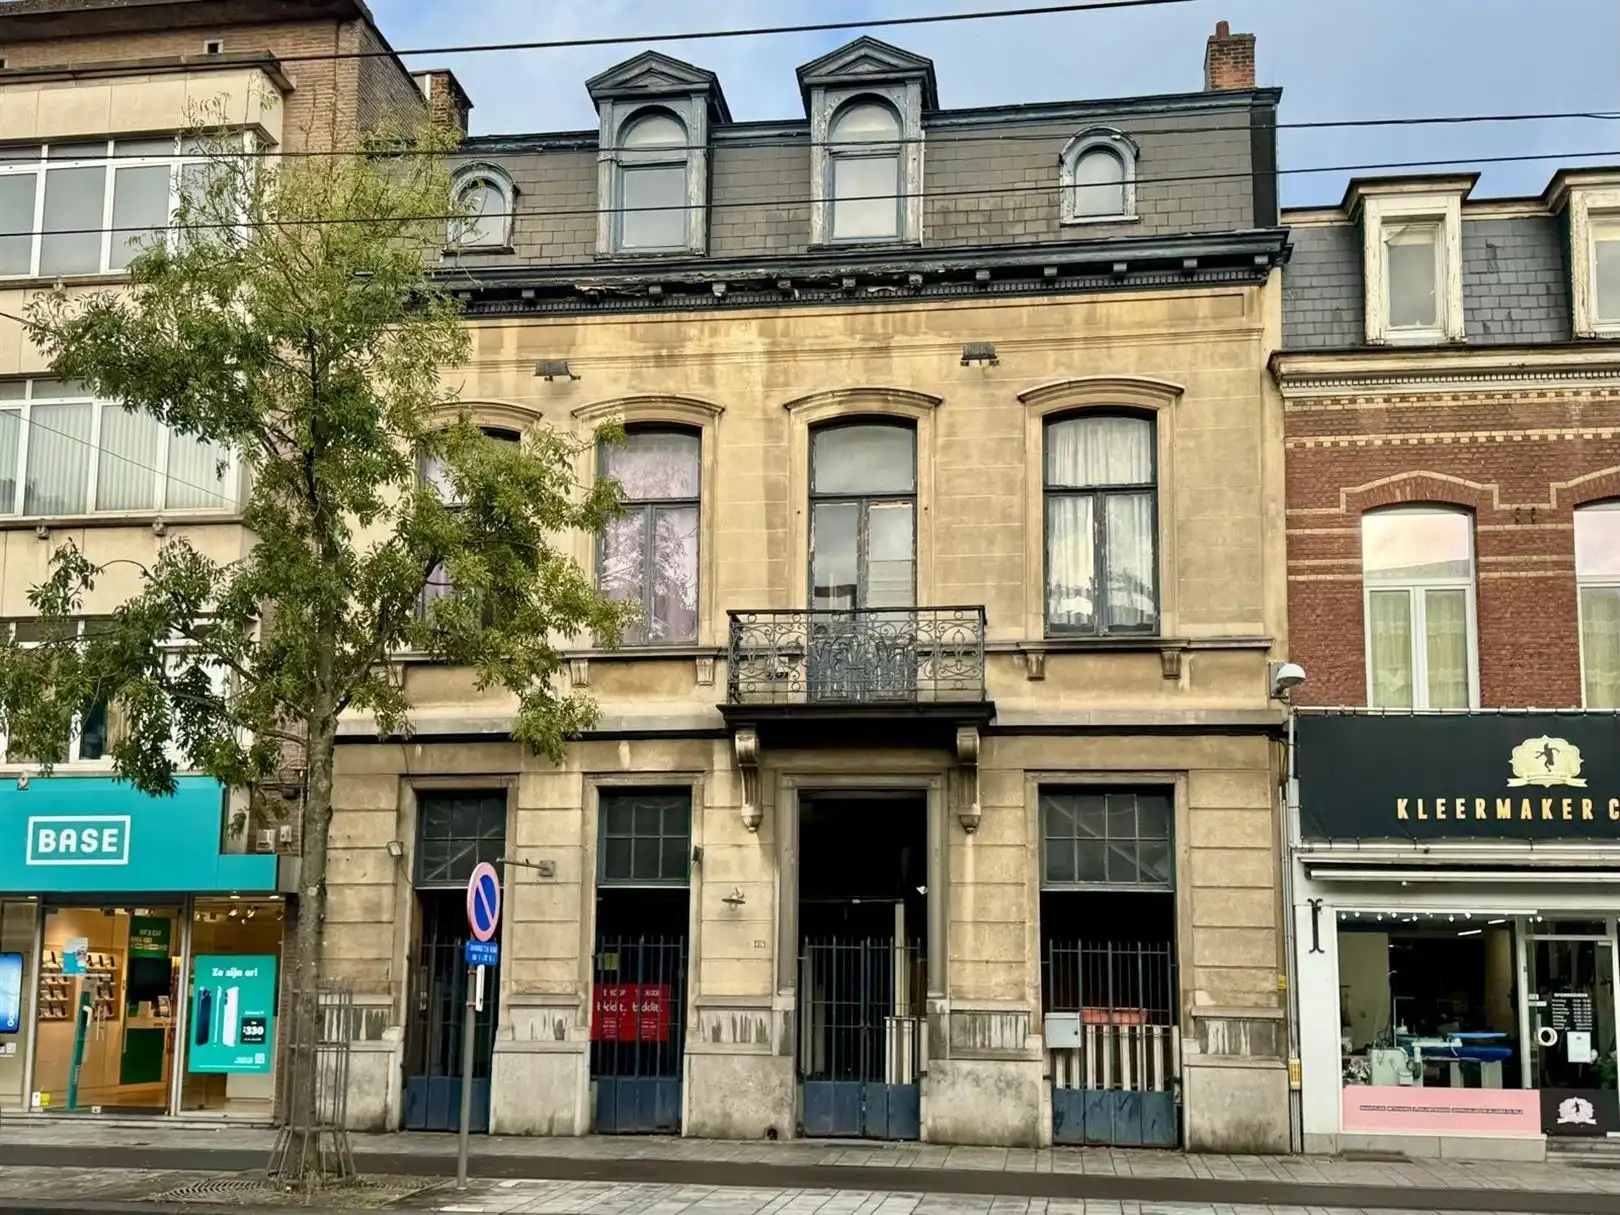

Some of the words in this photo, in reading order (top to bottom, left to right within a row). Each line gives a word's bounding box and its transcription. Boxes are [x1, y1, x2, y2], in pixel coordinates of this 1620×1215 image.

[1396, 798, 1594, 820] KLEERMAKER
[38, 828, 119, 853] BASE
[212, 967, 224, 977] Ze
